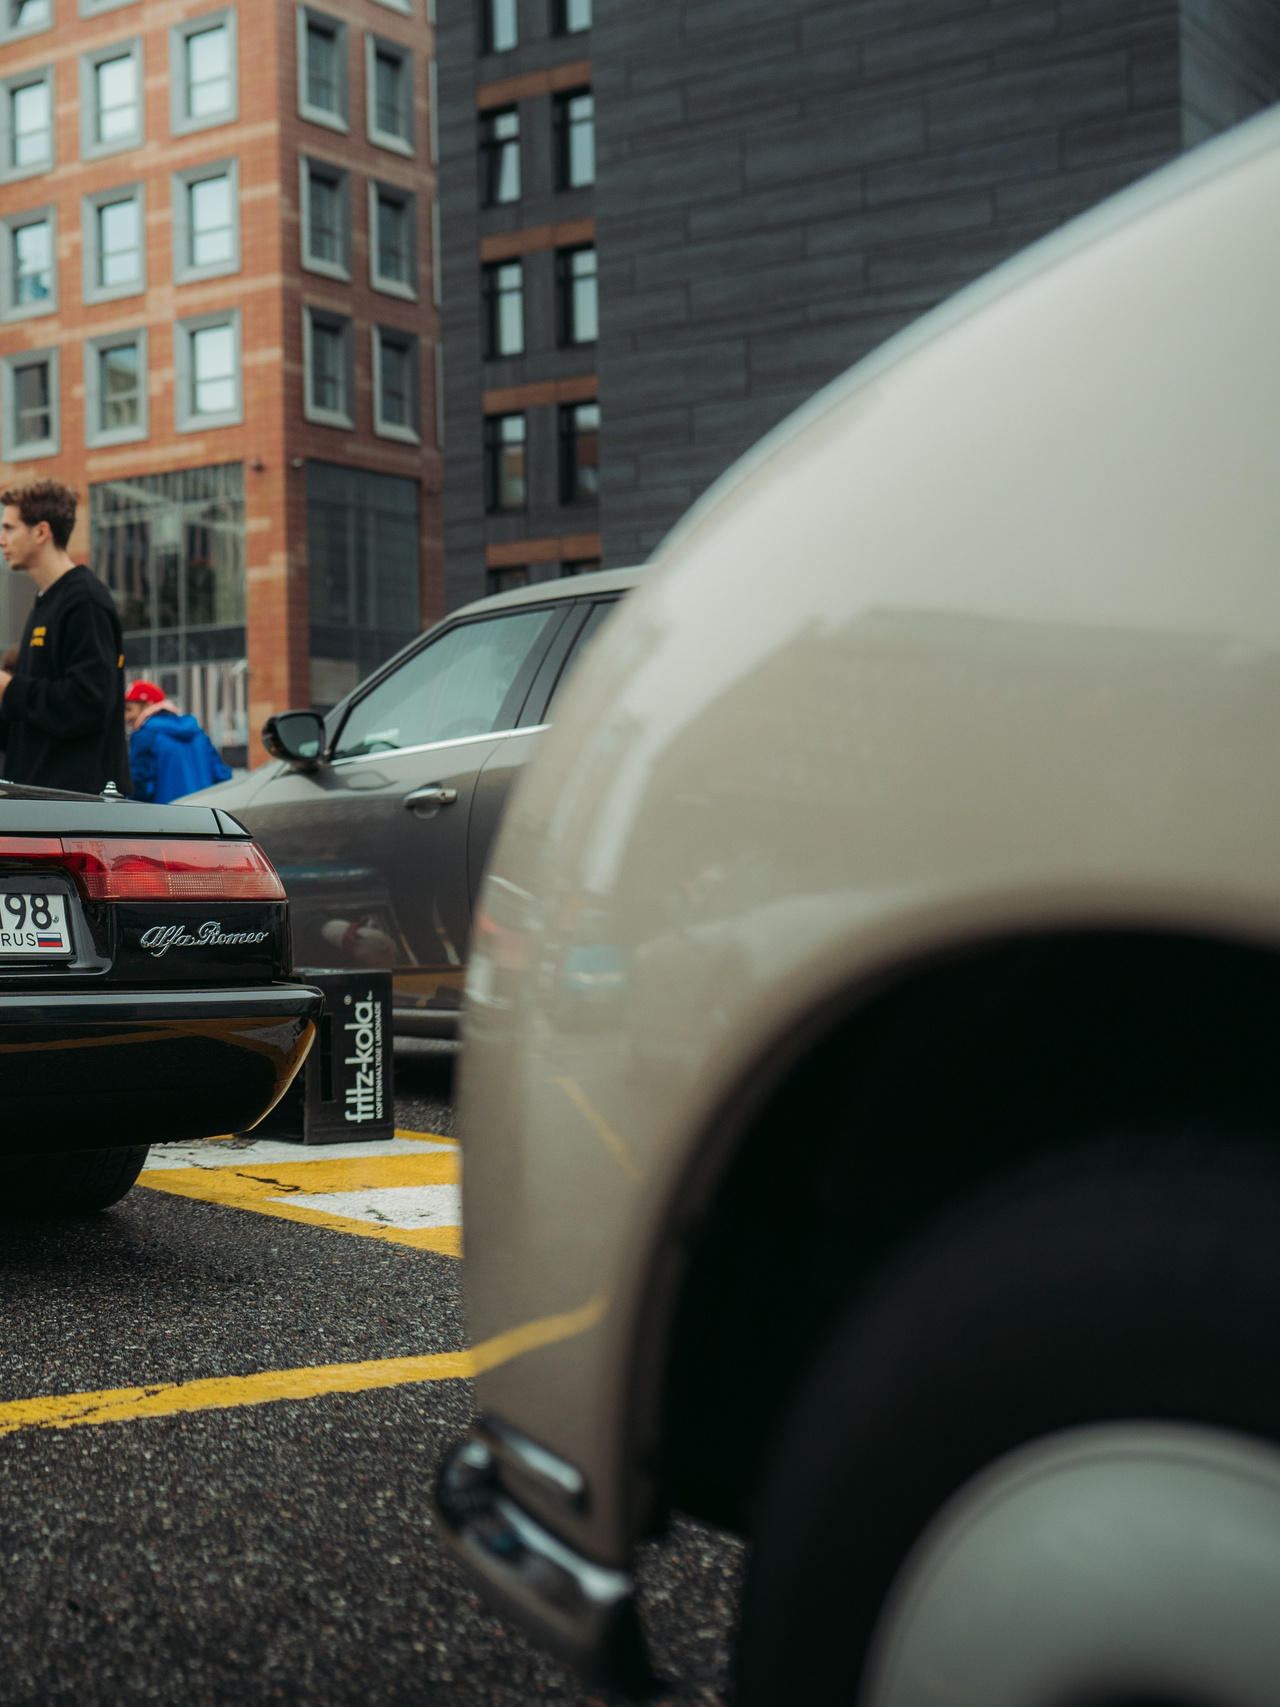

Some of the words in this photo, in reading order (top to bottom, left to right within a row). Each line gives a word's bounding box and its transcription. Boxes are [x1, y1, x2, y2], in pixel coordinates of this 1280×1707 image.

[1, 932, 36, 946] RUS
[140, 925, 195, 957] Alfa
[197, 921, 269, 945] Romeo
[374, 1001, 382, 1046] LIMONADE
